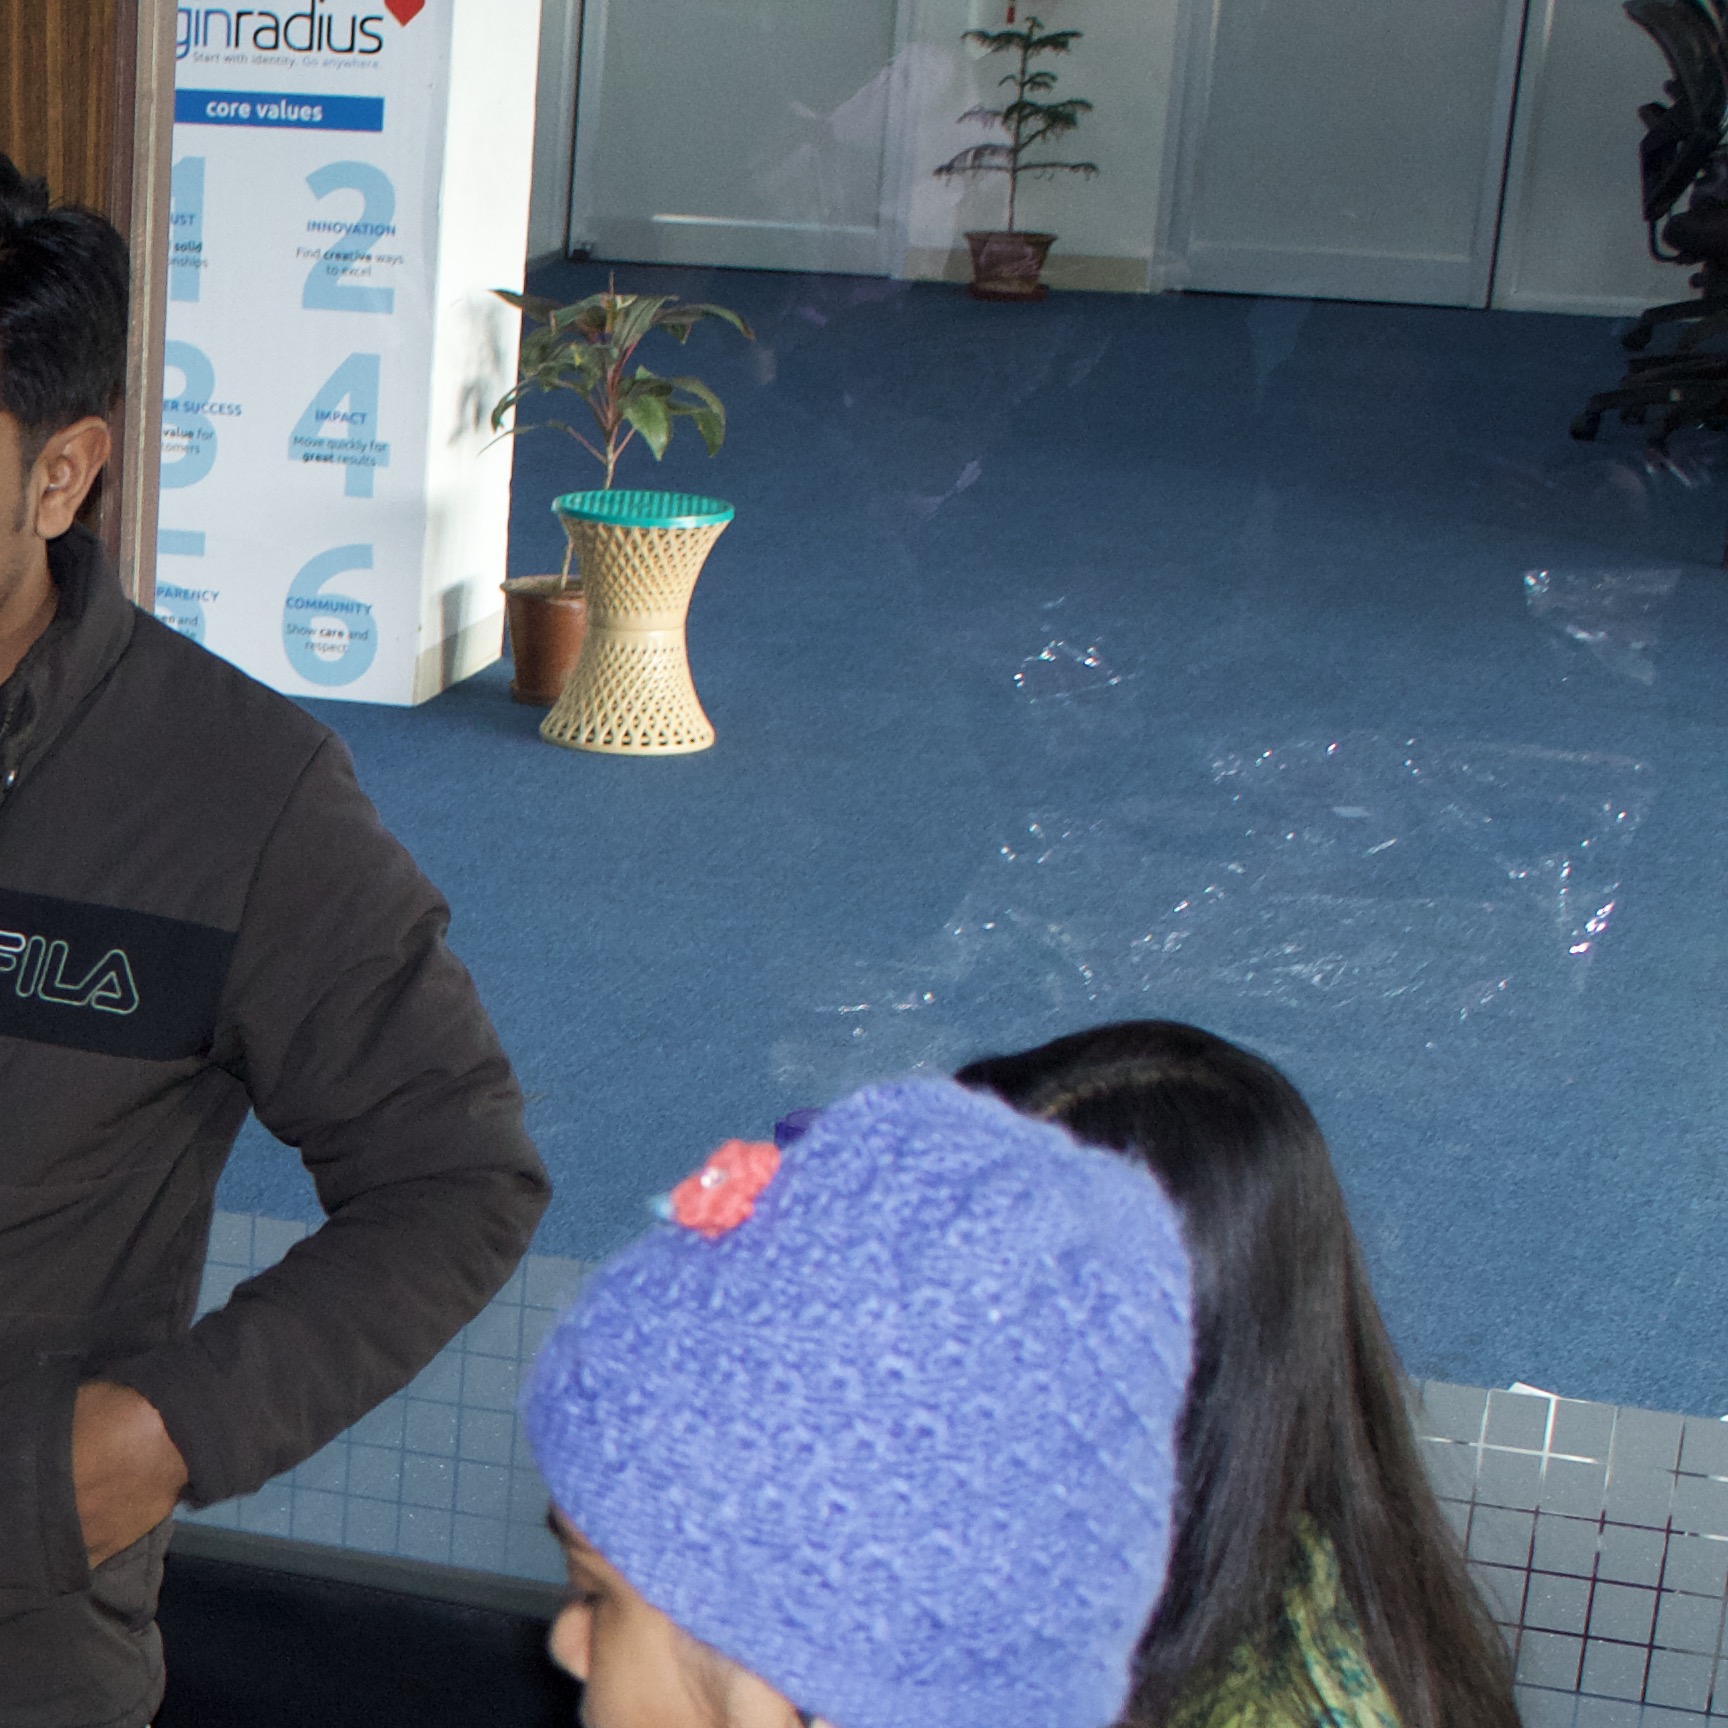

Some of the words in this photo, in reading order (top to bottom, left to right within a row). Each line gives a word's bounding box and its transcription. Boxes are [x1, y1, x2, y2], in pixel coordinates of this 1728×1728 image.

[193, 51, 220, 63] Start
[224, 53, 248, 64] with
[302, 56, 319, 67] Go
[205, 100, 252, 118] core
[256, 99, 323, 121] values
[306, 219, 396, 236] INNOVATION
[302, 161, 395, 313] 2
[175, 241, 202, 252] solid
[296, 247, 321, 258] Find
[324, 249, 372, 262] creative
[375, 253, 404, 266] ways
[326, 264, 338, 275] to
[341, 265, 372, 277] excel
[183, 402, 242, 416] SUCCESS
[288, 353, 389, 497] 4
[315, 410, 367, 425] IMPACT
[163, 427, 194, 438] value
[197, 426, 216, 439] for
[294, 436, 323, 448] Move
[326, 438, 367, 453] quickly
[370, 440, 387, 452] for
[302, 453, 334, 465] great
[337, 454, 377, 466] results
[286, 596, 373, 616] COMMUNITY
[178, 614, 199, 626] and
[284, 543, 377, 687] 6
[287, 623, 317, 635] Show
[319, 627, 345, 638] care
[347, 629, 369, 641] and
[305, 641, 349, 654] respect
